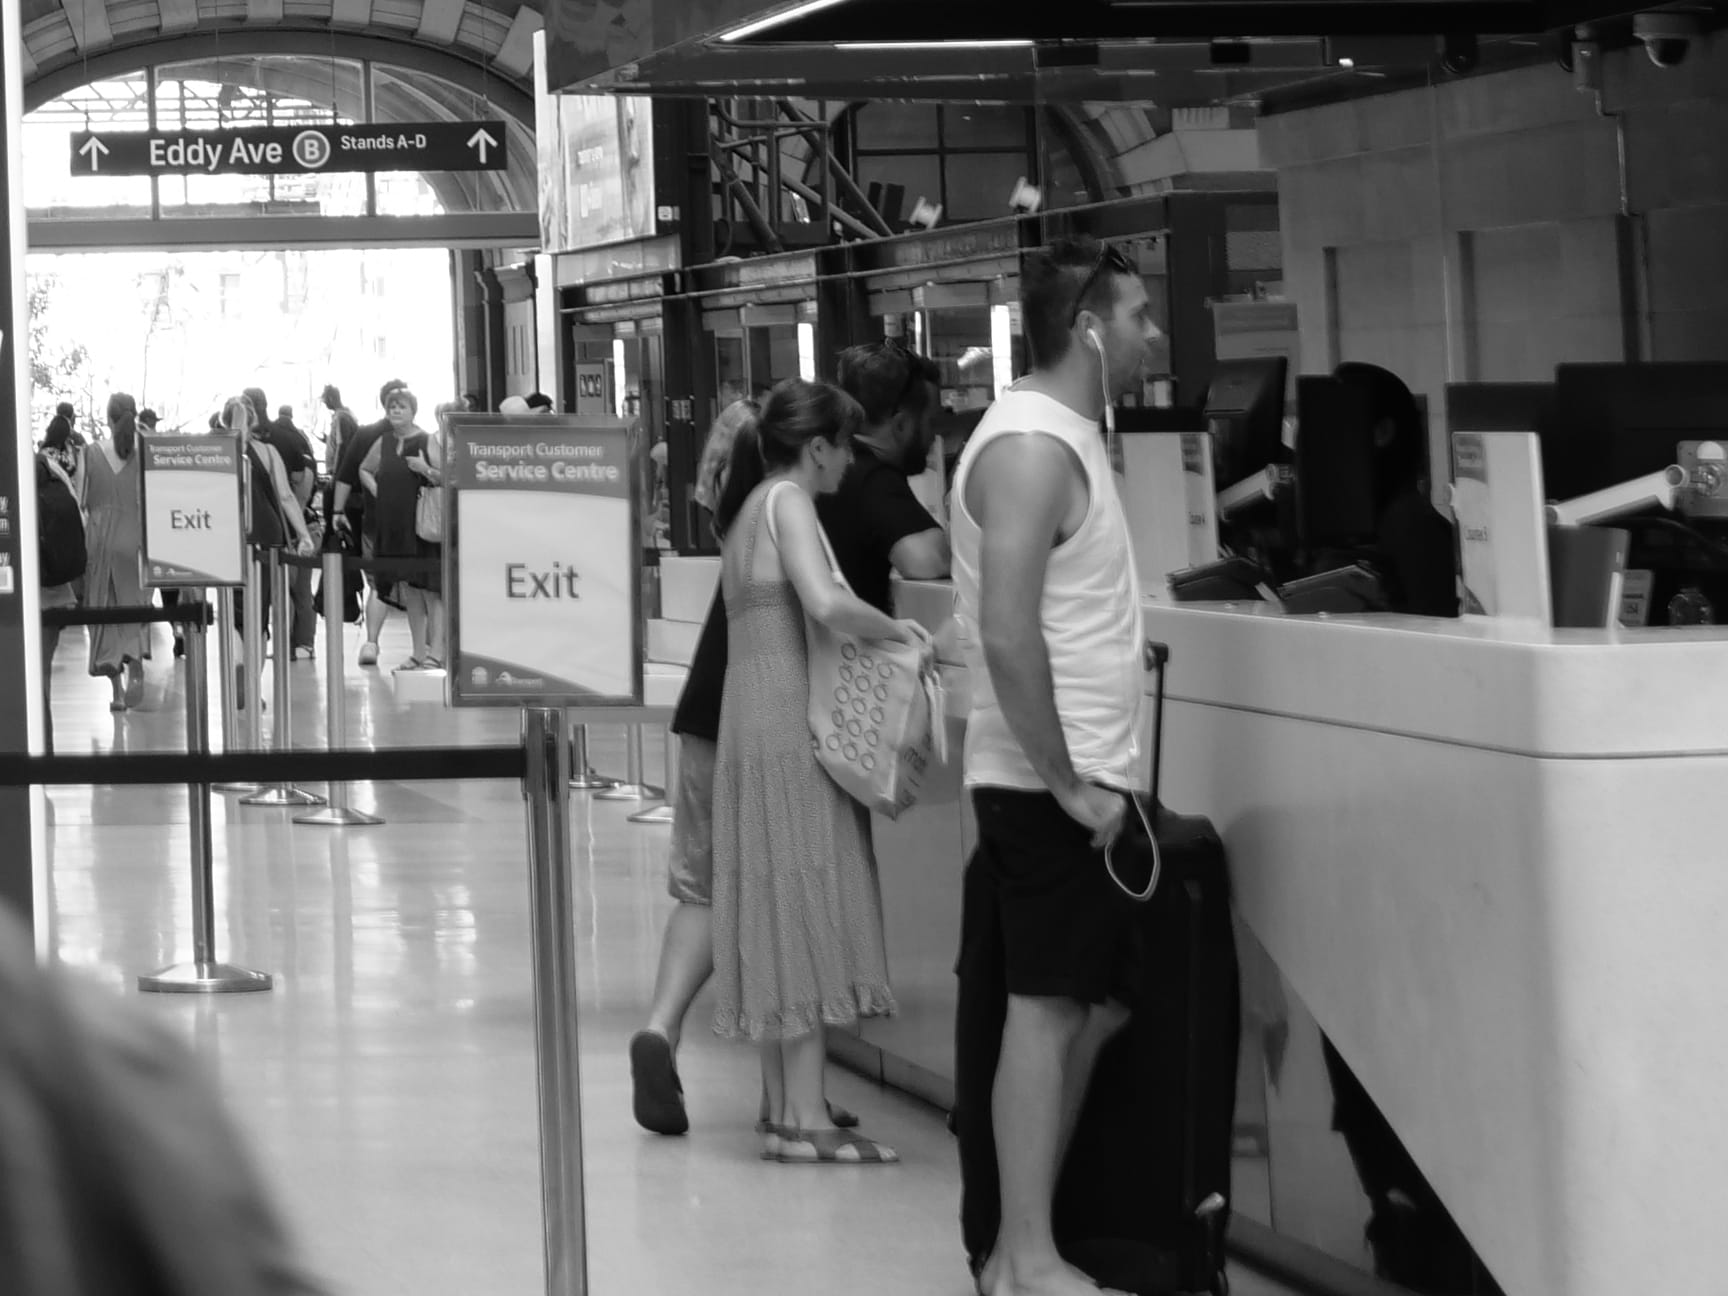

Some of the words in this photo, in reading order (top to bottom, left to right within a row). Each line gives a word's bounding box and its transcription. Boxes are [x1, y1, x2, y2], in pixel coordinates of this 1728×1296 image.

[149, 140, 223, 173] Eddy
[229, 139, 283, 166] Ave
[341, 134, 394, 152] Stands
[397, 133, 428, 150] A-D
[153, 454, 193, 465] Service
[194, 454, 232, 465] Centre
[467, 441, 534, 459] Transport
[535, 441, 603, 457] Customer
[475, 460, 547, 480] Service
[551, 461, 619, 481] Centre
[170, 508, 212, 529] Exit
[505, 561, 580, 599] Exit
